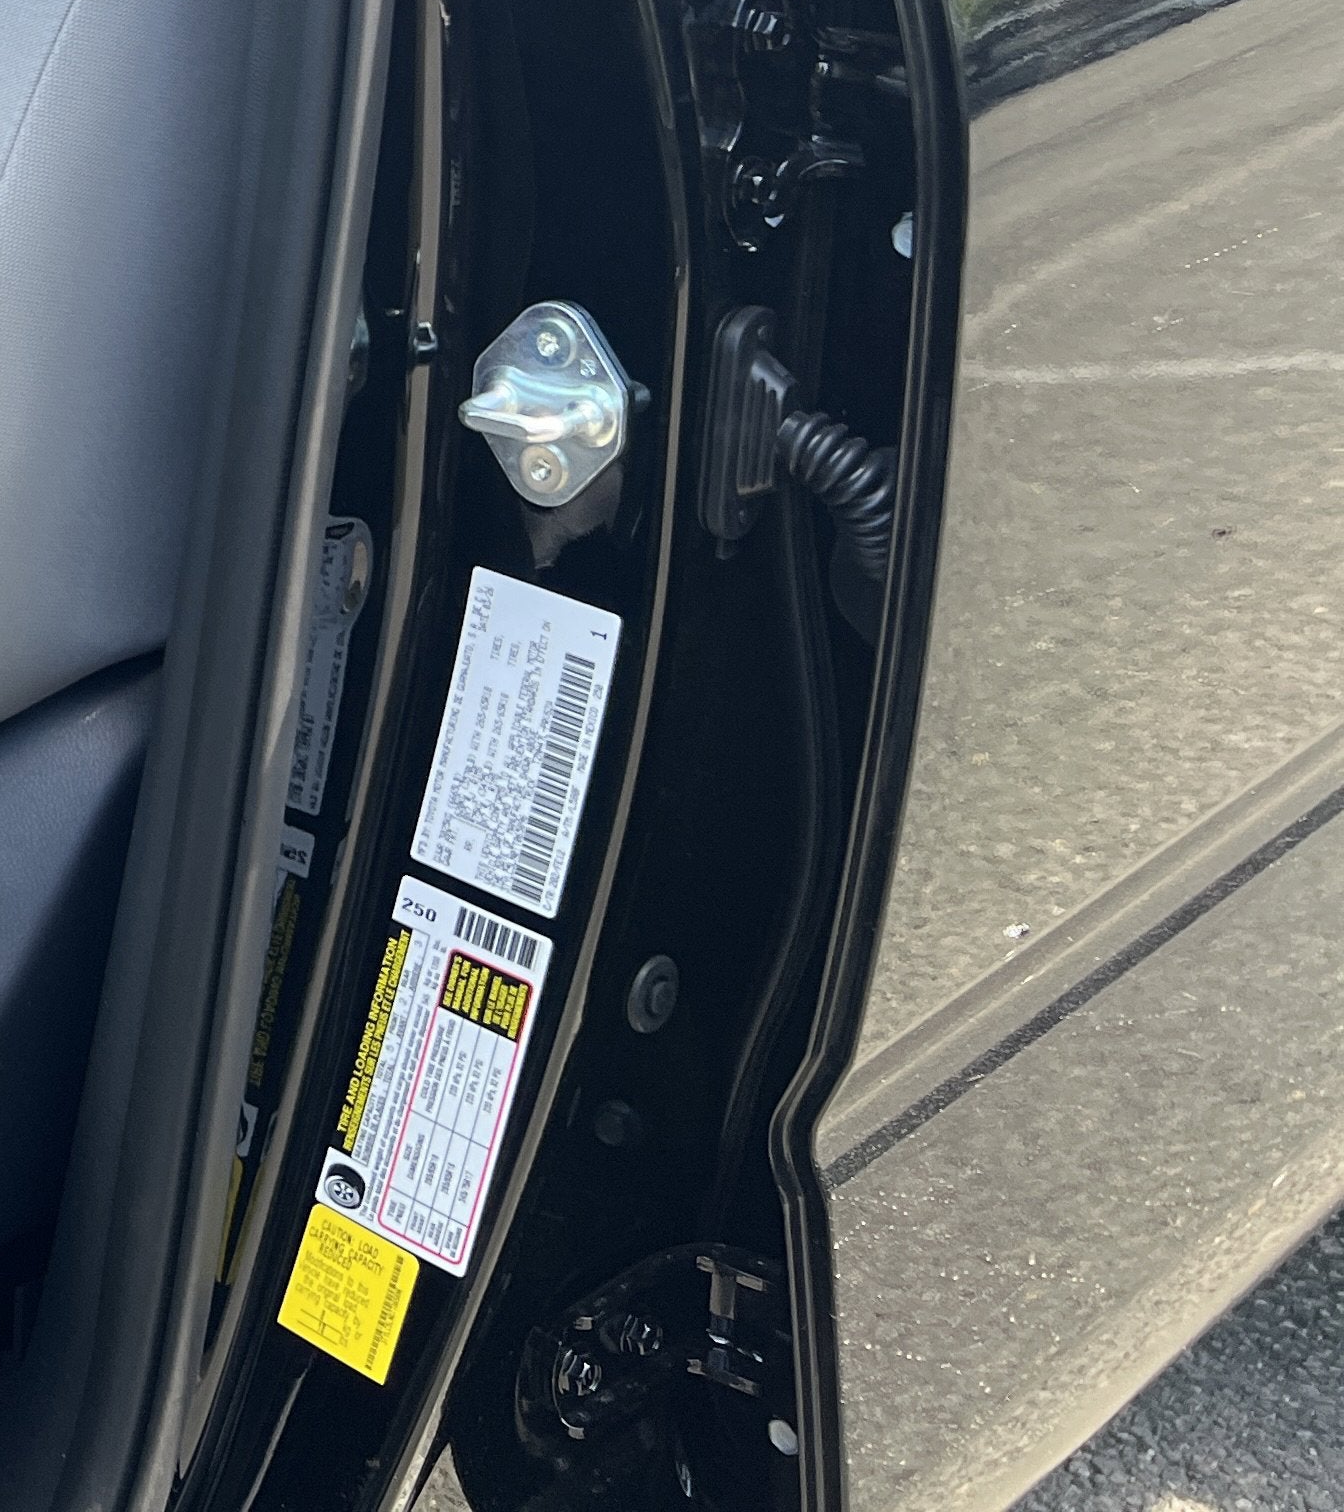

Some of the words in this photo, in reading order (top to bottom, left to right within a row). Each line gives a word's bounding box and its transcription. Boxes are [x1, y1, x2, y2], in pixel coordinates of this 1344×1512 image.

[402, 896, 435, 922] 250
[367, 936, 398, 1021] INFORMATION
[381, 998, 391, 1012] ET
[384, 986, 395, 1000] LE
[352, 1020, 375, 1077] LOADING
[369, 1039, 381, 1057] LES
[345, 1075, 360, 1105] AND
[337, 1102, 352, 1133] TIRE
[308, 1225, 346, 1253] CARRYING
[346, 1247, 384, 1276] CAPACITY
[317, 1243, 353, 1270] REDUCED
[357, 1239, 379, 1259] LOAD
